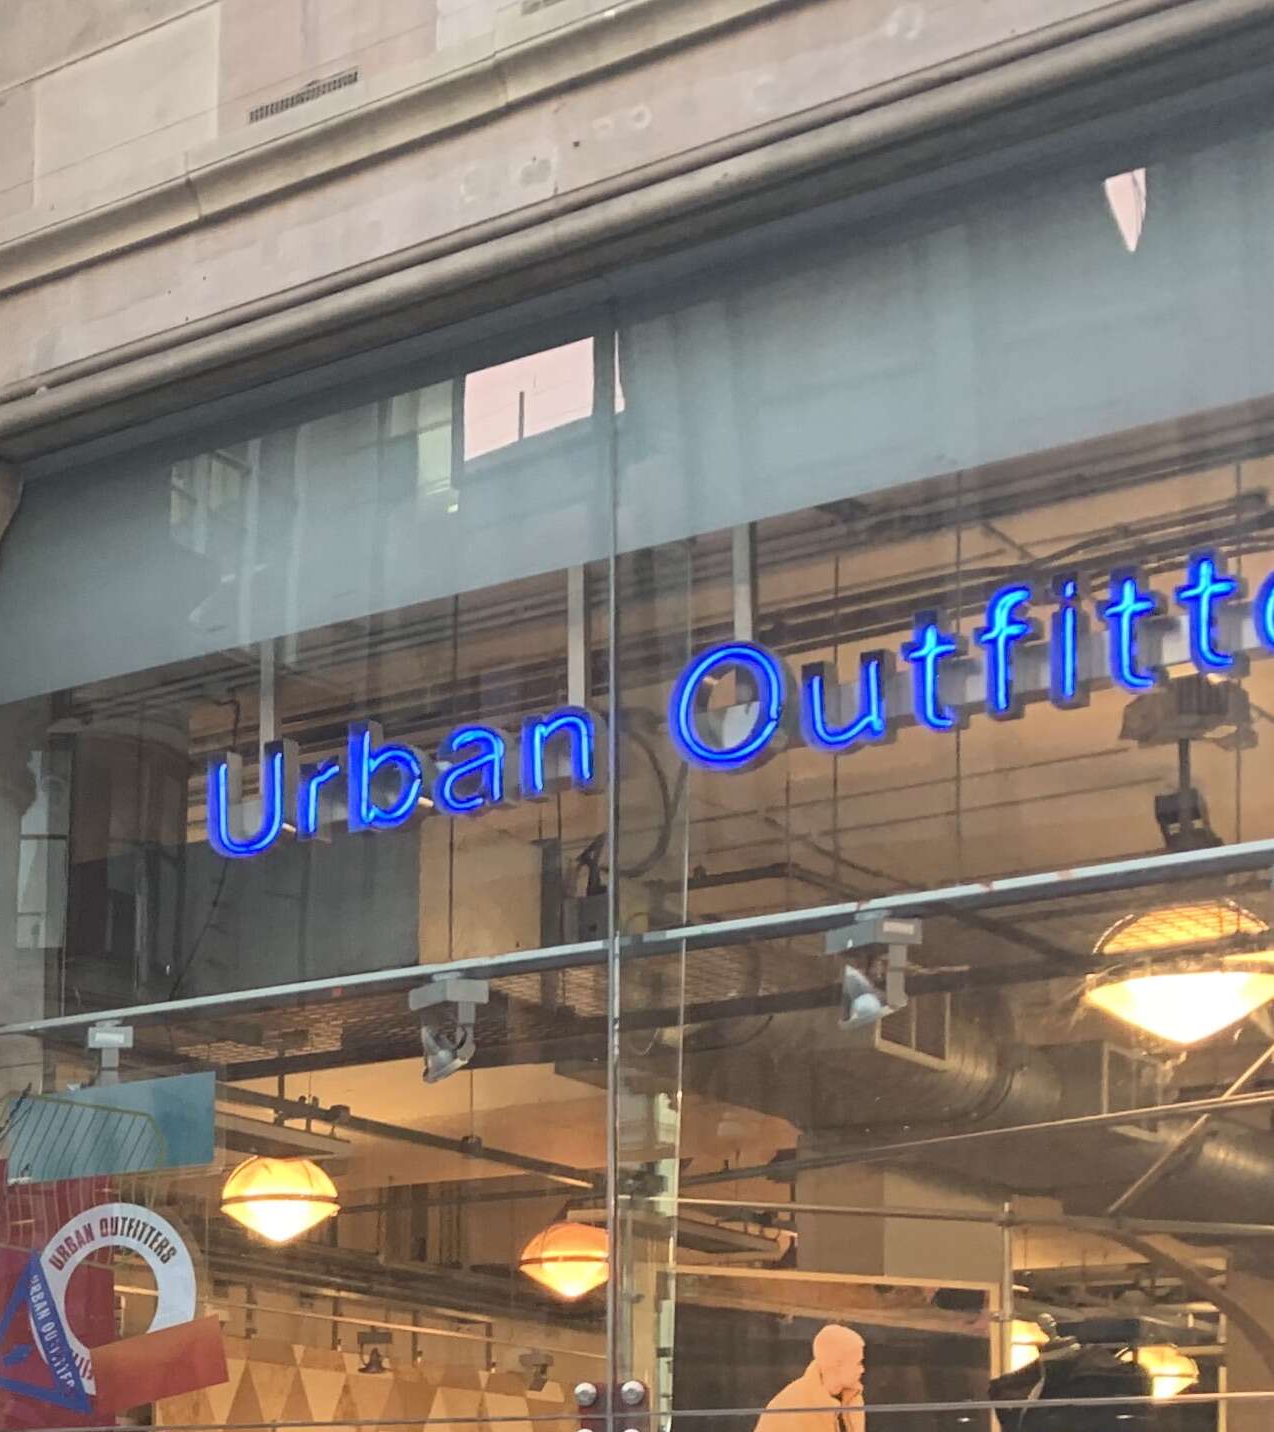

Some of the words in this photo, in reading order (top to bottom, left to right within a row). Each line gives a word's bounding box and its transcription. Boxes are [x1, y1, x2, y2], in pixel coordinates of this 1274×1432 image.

[207, 704, 596, 858] Urban
[48, 1222, 96, 1271] URBAN
[99, 1216, 178, 1264] OUTFITTERS
